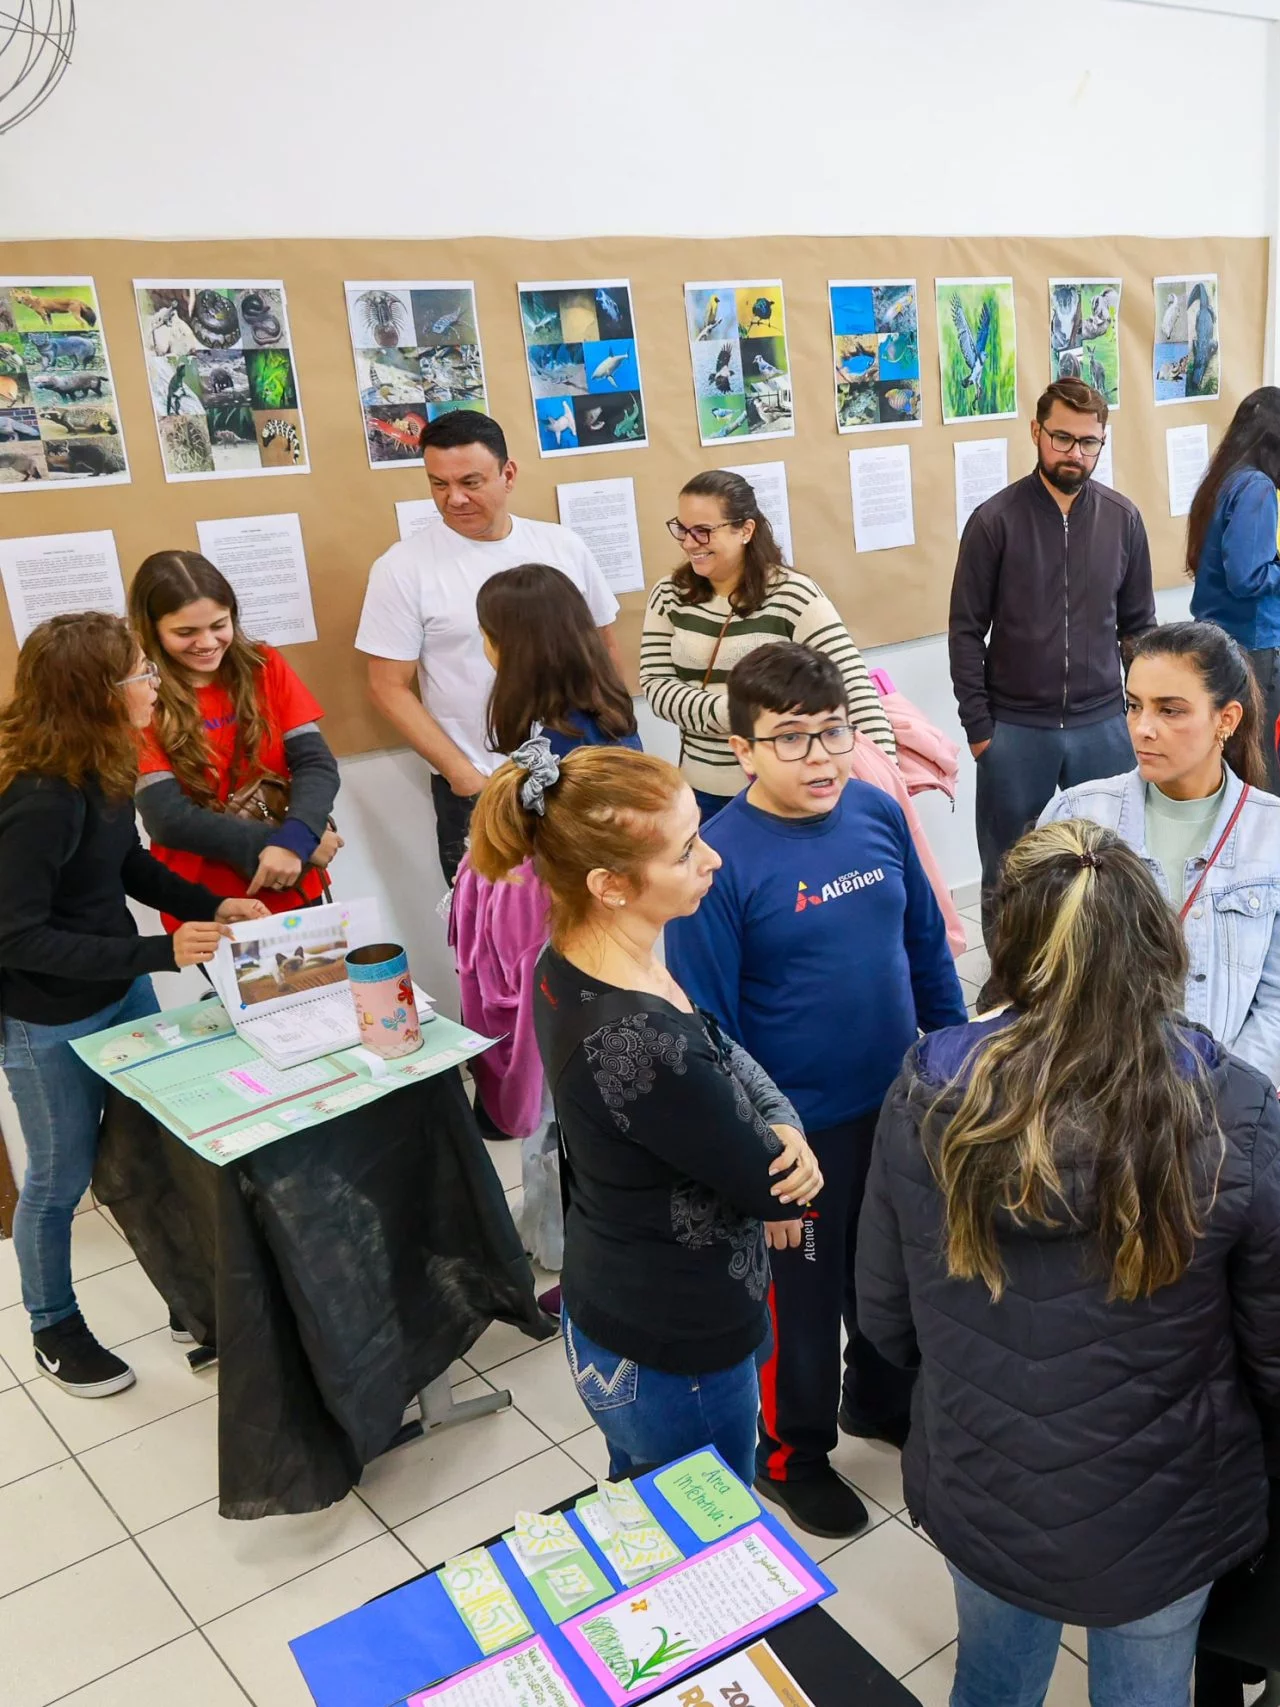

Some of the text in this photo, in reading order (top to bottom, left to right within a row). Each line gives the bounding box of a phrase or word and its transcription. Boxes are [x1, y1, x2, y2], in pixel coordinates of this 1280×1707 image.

[821, 867, 885, 902] Ateneu
[803, 1220, 816, 1262] Ateneu
[527, 1523, 565, 1540] 3
[619, 1536, 660, 1562] 2
[450, 1567, 484, 1591] 6
[558, 1570, 579, 1590] 4
[470, 1603, 516, 1631] 5
